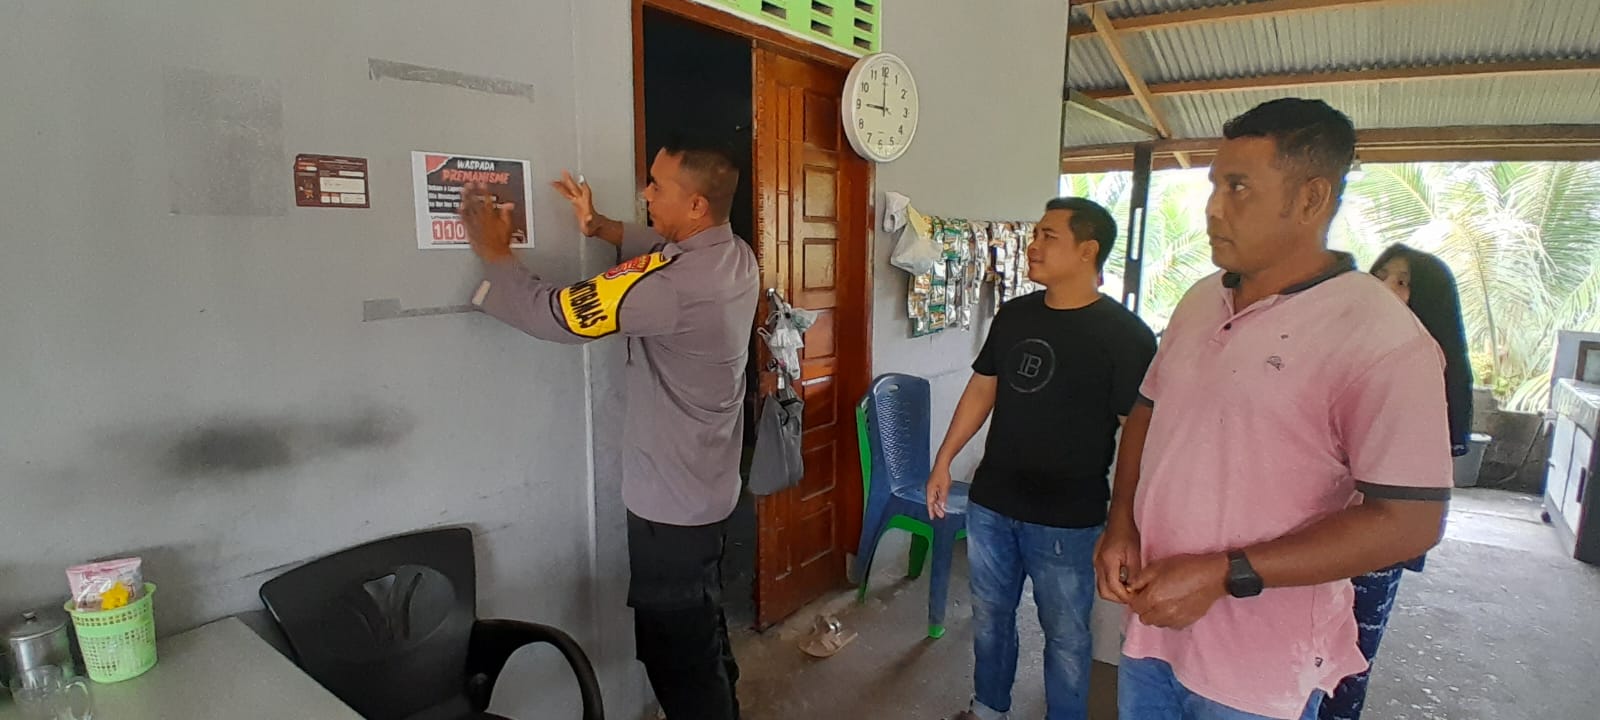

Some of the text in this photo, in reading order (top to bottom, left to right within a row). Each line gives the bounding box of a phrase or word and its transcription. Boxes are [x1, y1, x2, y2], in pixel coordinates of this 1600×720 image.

[870, 69, 877, 80] 11
[882, 67, 889, 78] 12
[861, 82, 869, 93] 10
[901, 89, 907, 99] 2
[856, 99, 861, 109] 9
[903, 108, 908, 118] 3
[859, 119, 864, 129] 8
[898, 125, 903, 135] 4
[867, 133, 872, 143] 7
[890, 137, 894, 146] 5
[878, 139, 883, 149] 6
[457, 160, 495, 171] WASPADA
[443, 170, 509, 184] PREMANISME
[434, 223, 464, 238] 110
